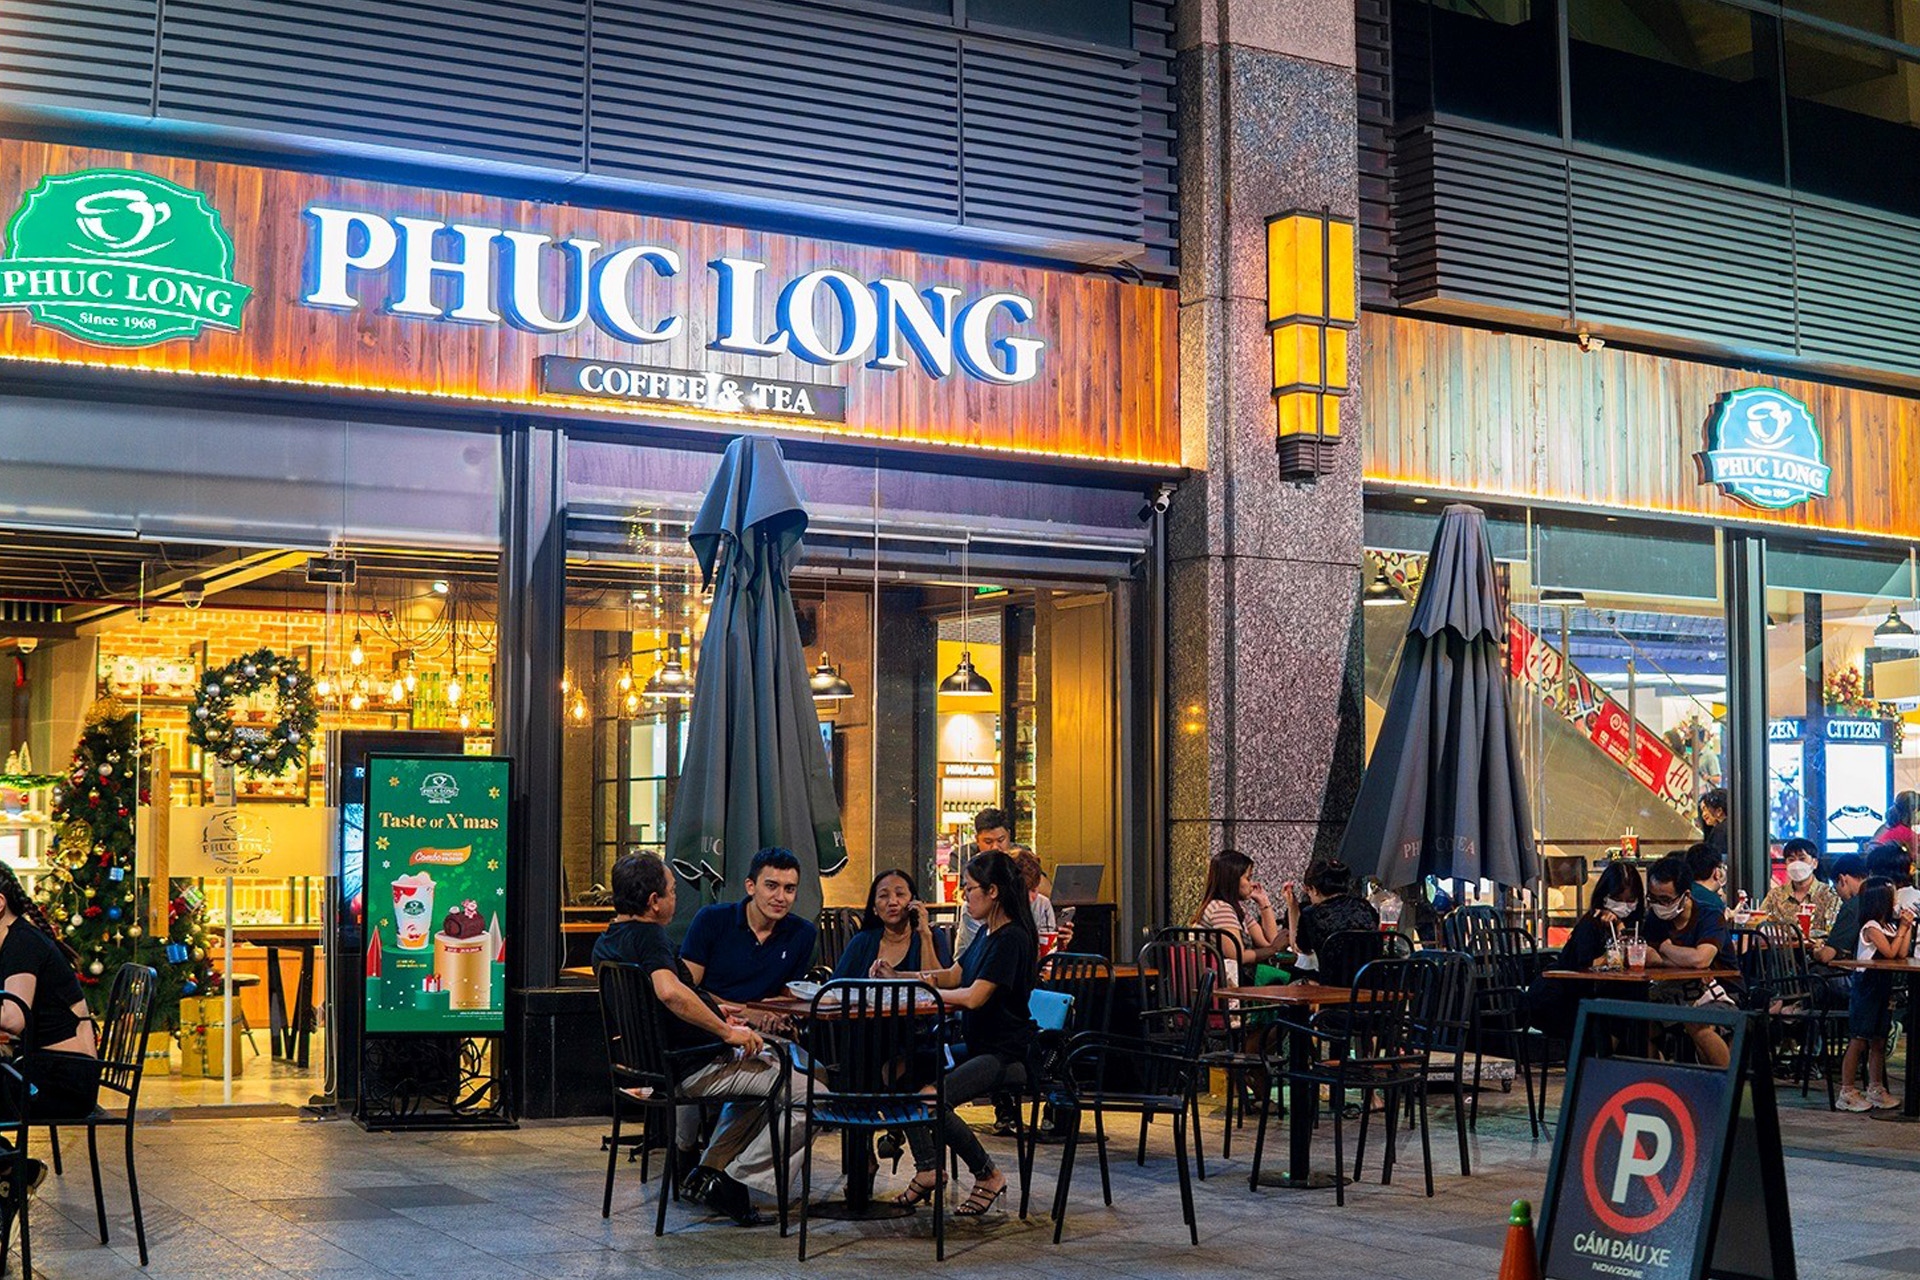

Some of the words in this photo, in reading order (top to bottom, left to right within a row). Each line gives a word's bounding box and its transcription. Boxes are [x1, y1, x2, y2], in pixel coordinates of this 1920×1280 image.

[1, 269, 113, 297] PHUC
[125, 273, 233, 317] LONG
[305, 207, 682, 343] PHUC
[706, 257, 1045, 385] LONG
[79, 311, 119, 327] Since
[123, 317, 157, 330] 1968
[578, 365, 707, 404] COFFEE
[717, 380, 745, 411] &
[752, 382, 815, 415] TEA
[1716, 456, 1769, 477] PHUC
[1772, 459, 1823, 489] LONG
[1769, 721, 1799, 738] ZEN
[1827, 720, 1882, 738] CITIZEN
[378, 812, 427, 829] Taste
[446, 813, 499, 829] X'mas
[203, 841, 237, 853] PHUC
[1611, 1112, 1672, 1203] P
[1573, 1230, 1610, 1256] CẤM
[1647, 1247, 1671, 1268] XE
[1591, 1261, 1644, 1279] NOWZONE
